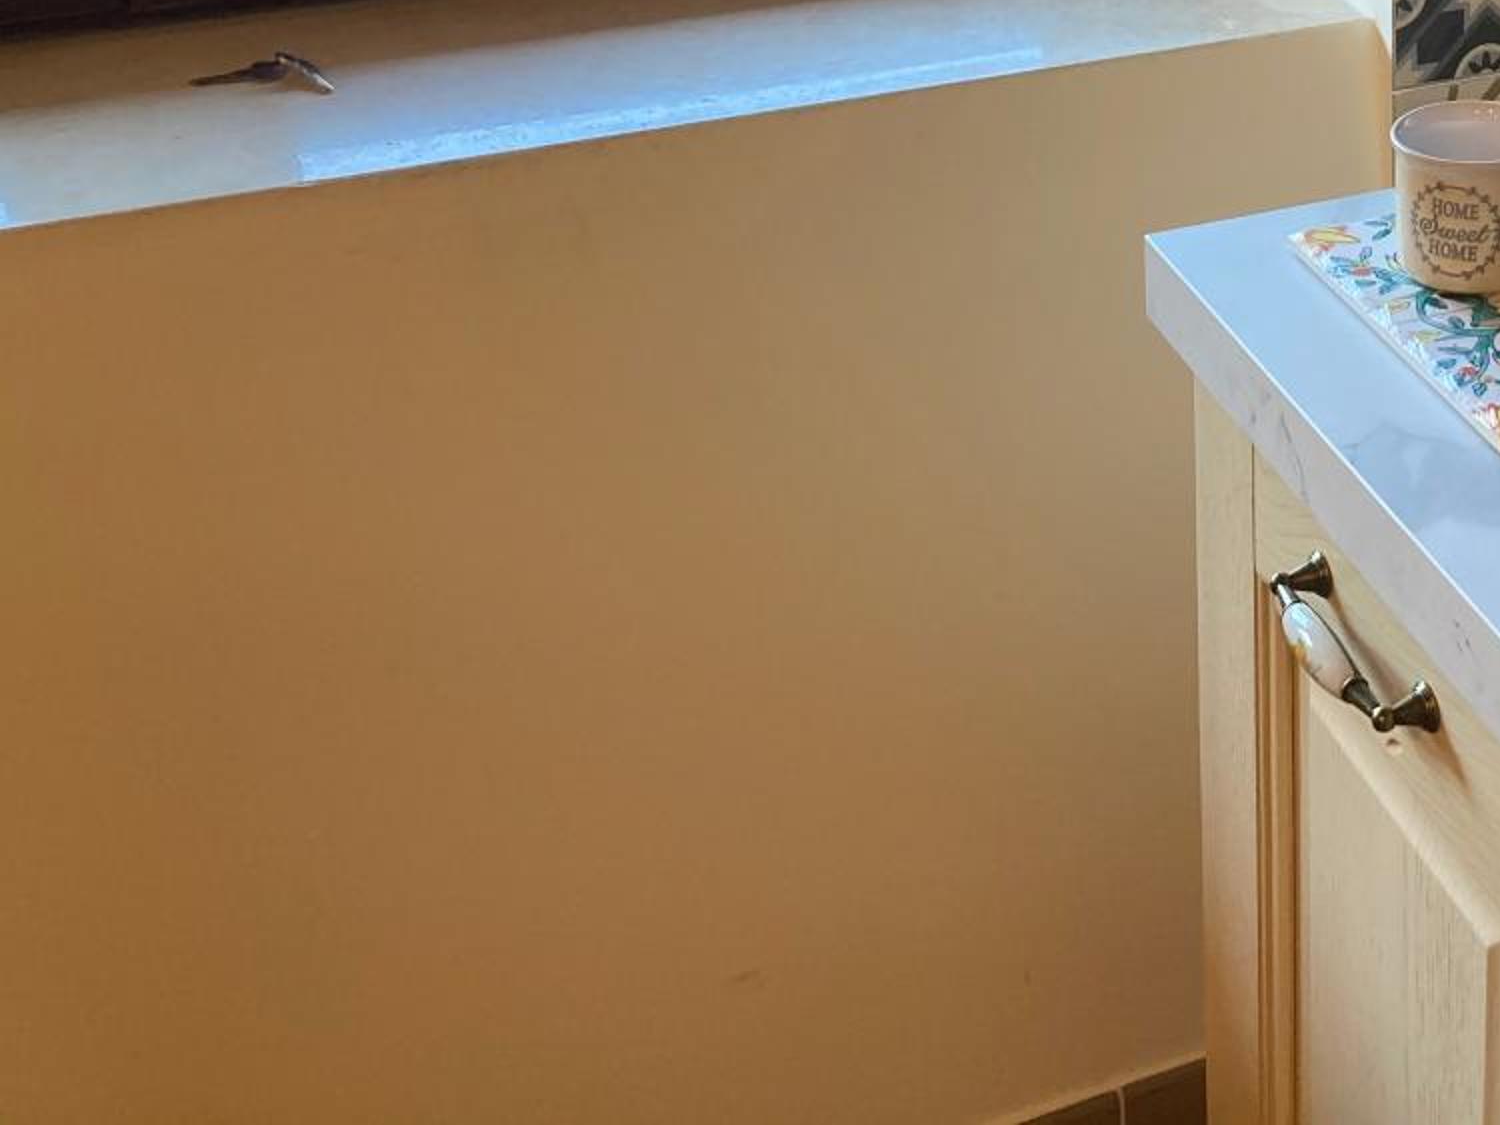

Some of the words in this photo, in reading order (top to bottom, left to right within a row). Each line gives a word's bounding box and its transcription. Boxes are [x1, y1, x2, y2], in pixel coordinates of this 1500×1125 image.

[1431, 196, 1480, 220] HOME
[1419, 214, 1495, 242] Sweet
[1428, 237, 1479, 262] HOME
